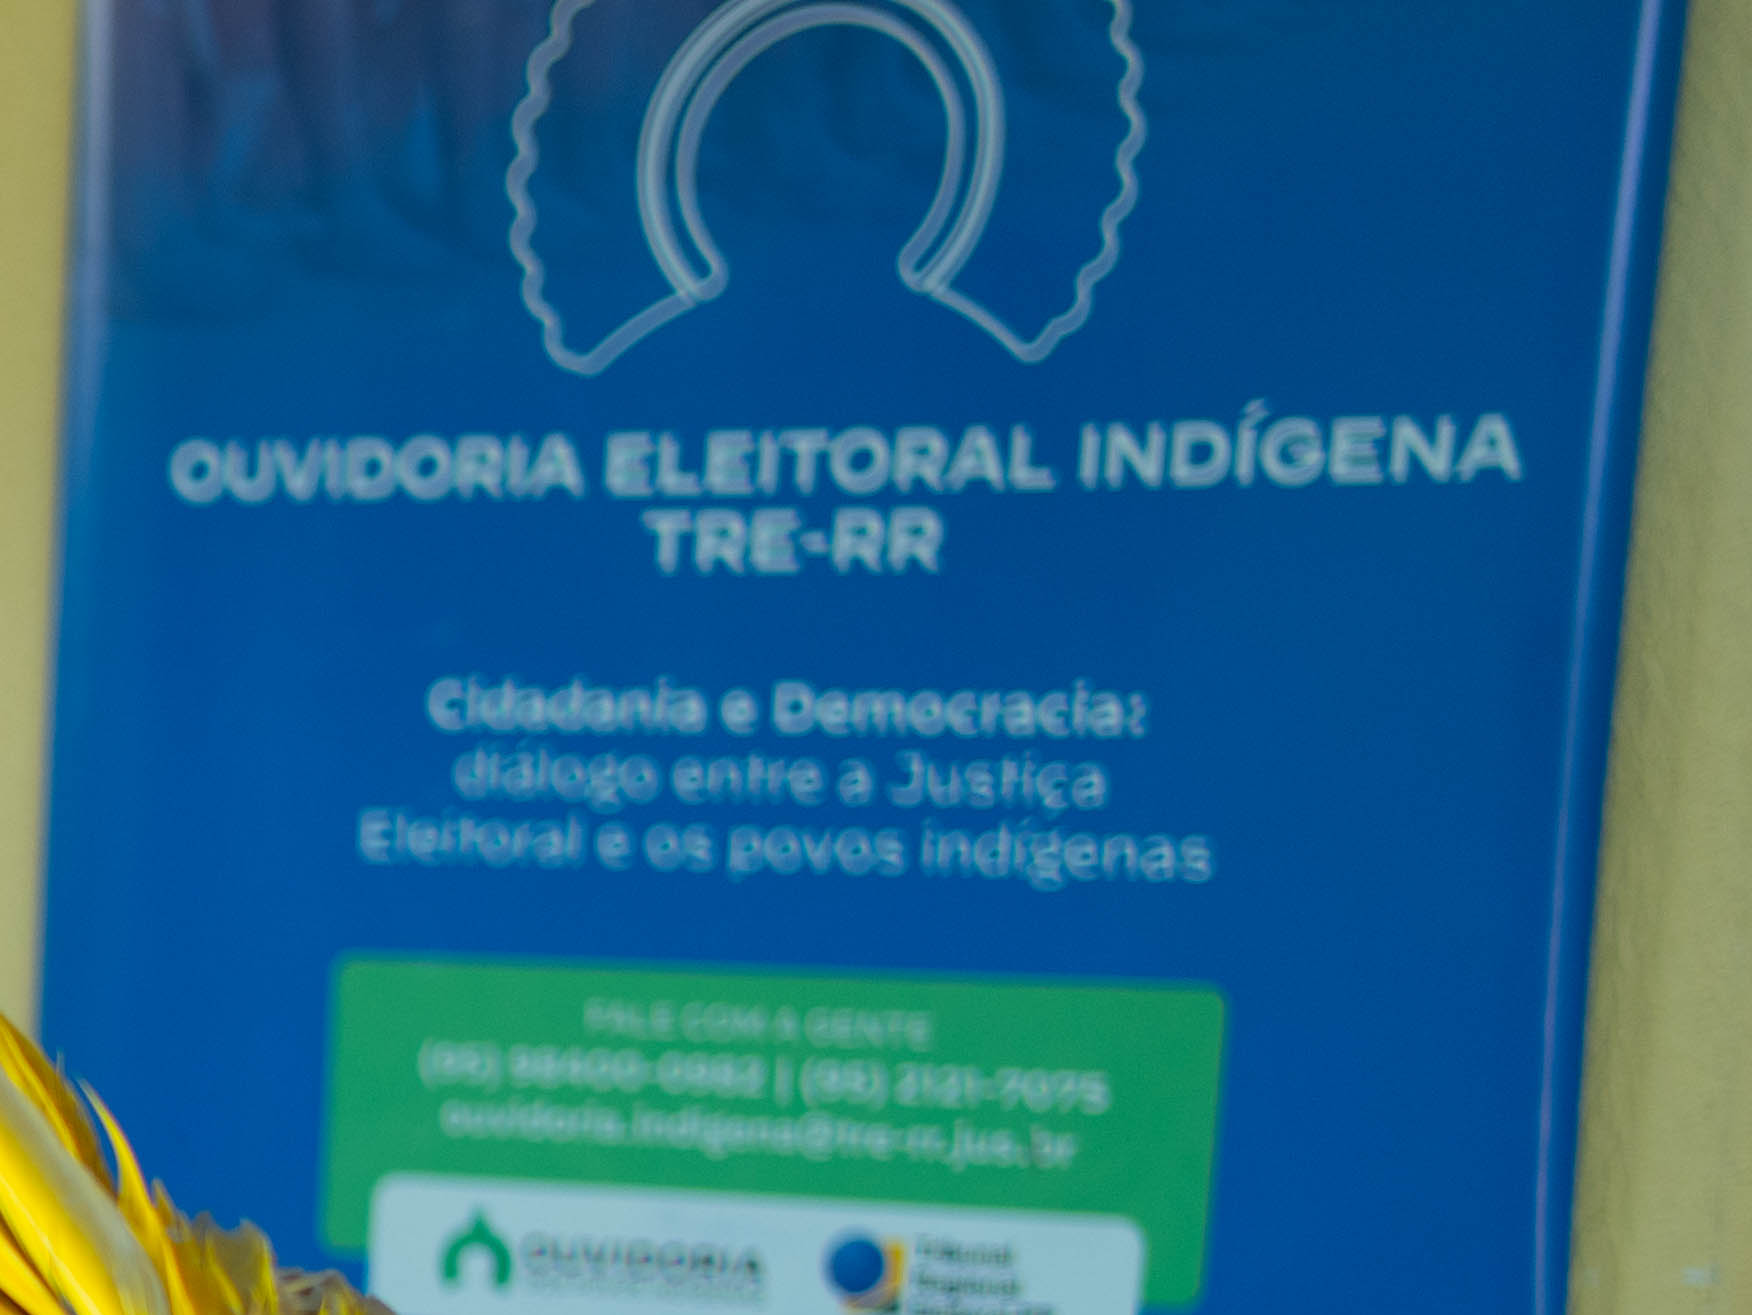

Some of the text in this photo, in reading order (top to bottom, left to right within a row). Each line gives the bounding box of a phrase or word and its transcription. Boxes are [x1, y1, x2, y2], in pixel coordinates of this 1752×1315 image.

[168, 398, 1524, 505] OUVIDORIA ELEITORAL INDÍGENA
[640, 506, 944, 576] TRE-RR
[426, 675, 1146, 740] Cidadania e Democracia:
[453, 740, 1110, 818] diálogo entre a Justiça
[358, 808, 1217, 891] Eleitoral e os povos indígenas
